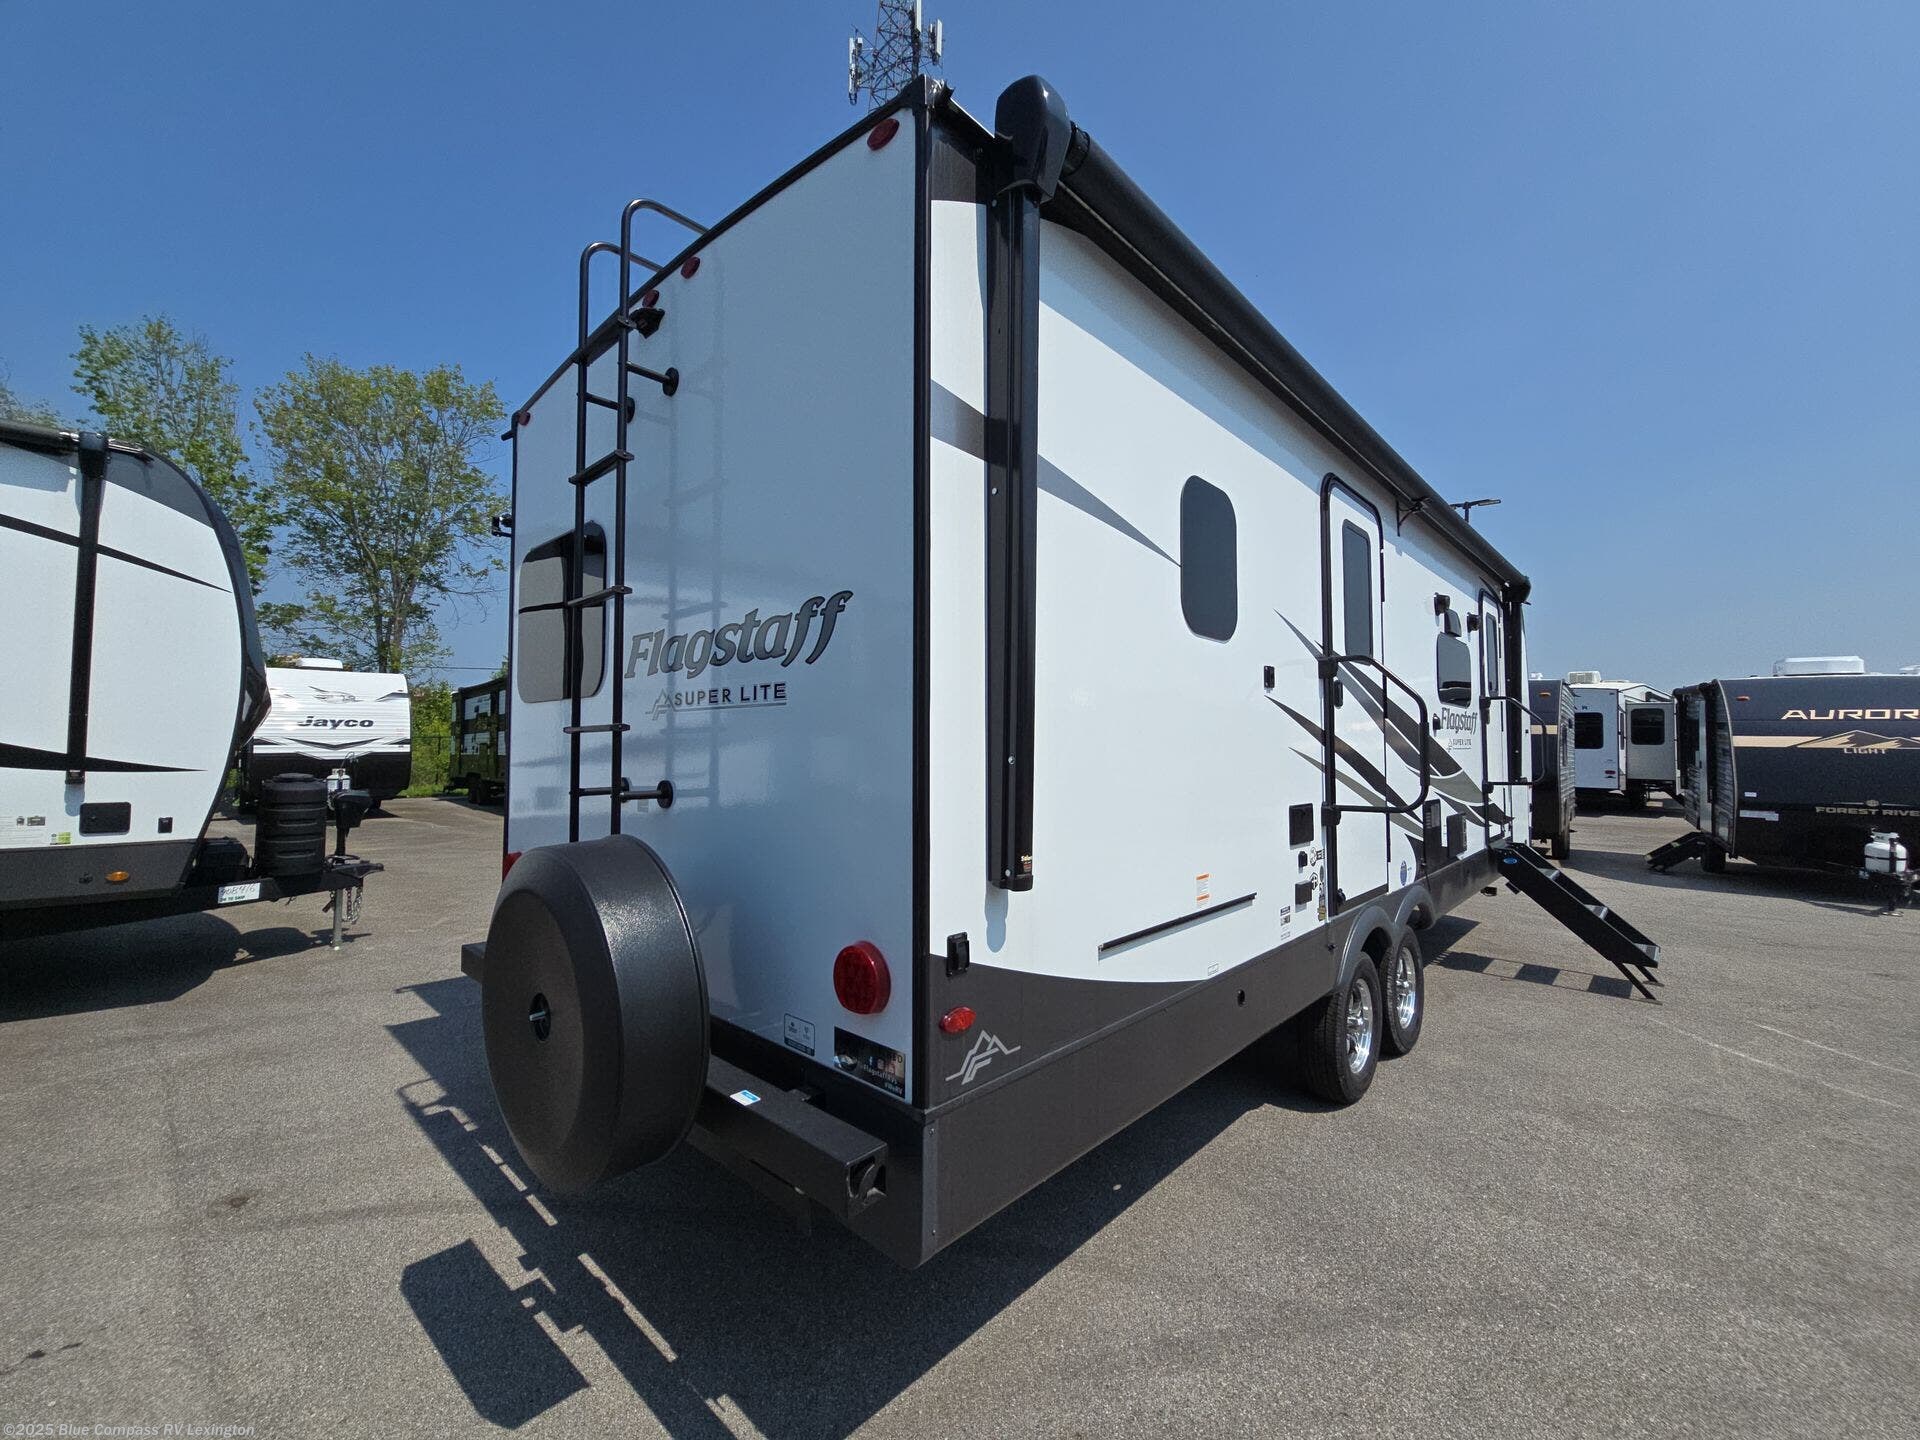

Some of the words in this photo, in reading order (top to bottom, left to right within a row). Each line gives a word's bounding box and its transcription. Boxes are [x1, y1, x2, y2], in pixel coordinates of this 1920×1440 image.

[624, 590, 854, 680] Flagstaff
[674, 688, 731, 706] SUPER
[740, 683, 787, 701] LITE
[297, 715, 374, 730] Jayco
[1441, 707, 1478, 735] Flagstaff
[1843, 747, 1887, 755] LIGHT
[1815, 806, 1879, 816] FOREST
